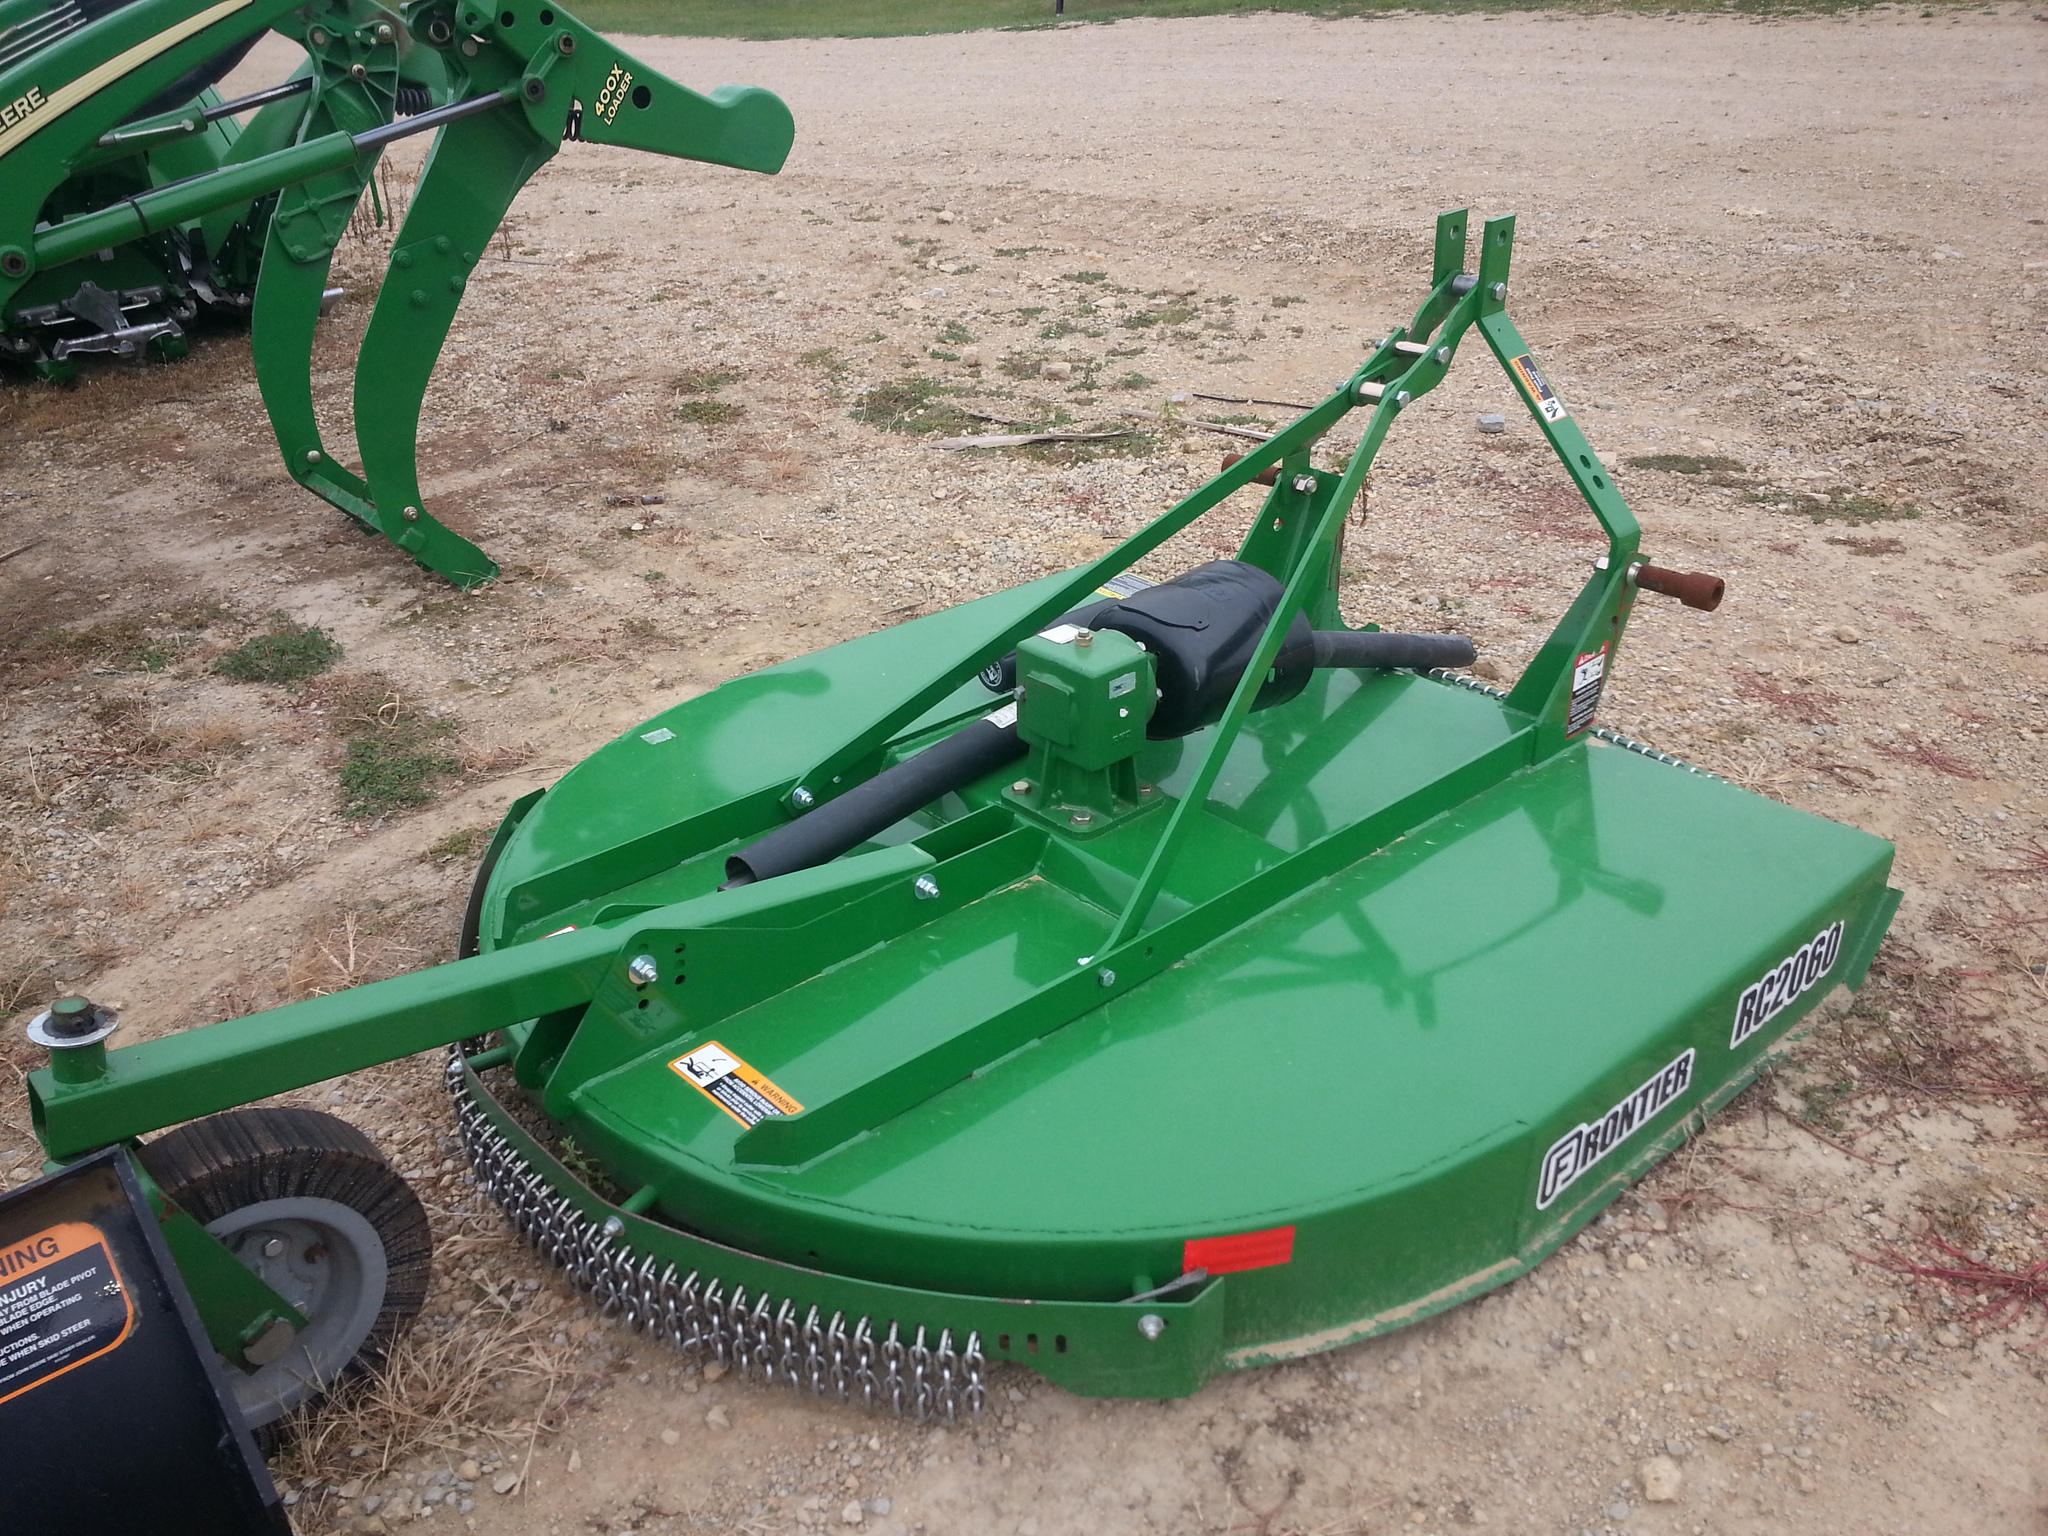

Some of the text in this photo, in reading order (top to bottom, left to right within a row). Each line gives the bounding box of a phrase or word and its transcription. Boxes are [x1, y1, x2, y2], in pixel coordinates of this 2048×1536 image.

[595, 62, 623, 116] 400X
[604, 72, 633, 126] LOADER
[1732, 922, 1842, 1044] RC2060
[760, 1083, 797, 1113] WARNING
[1539, 1050, 1693, 1205] FRONTIER
[11, 1294, 38, 1312] FROM
[39, 1279, 71, 1298] BLADE
[70, 1267, 97, 1285] PIVOT
[29, 1295, 58, 1312] EDGE.
[0, 1293, 82, 1335] WHEN OPERATING
[8, 1344, 37, 1361] WHEN
[38, 1333, 60, 1348] SKID
[60, 1318, 91, 1337] STEER
